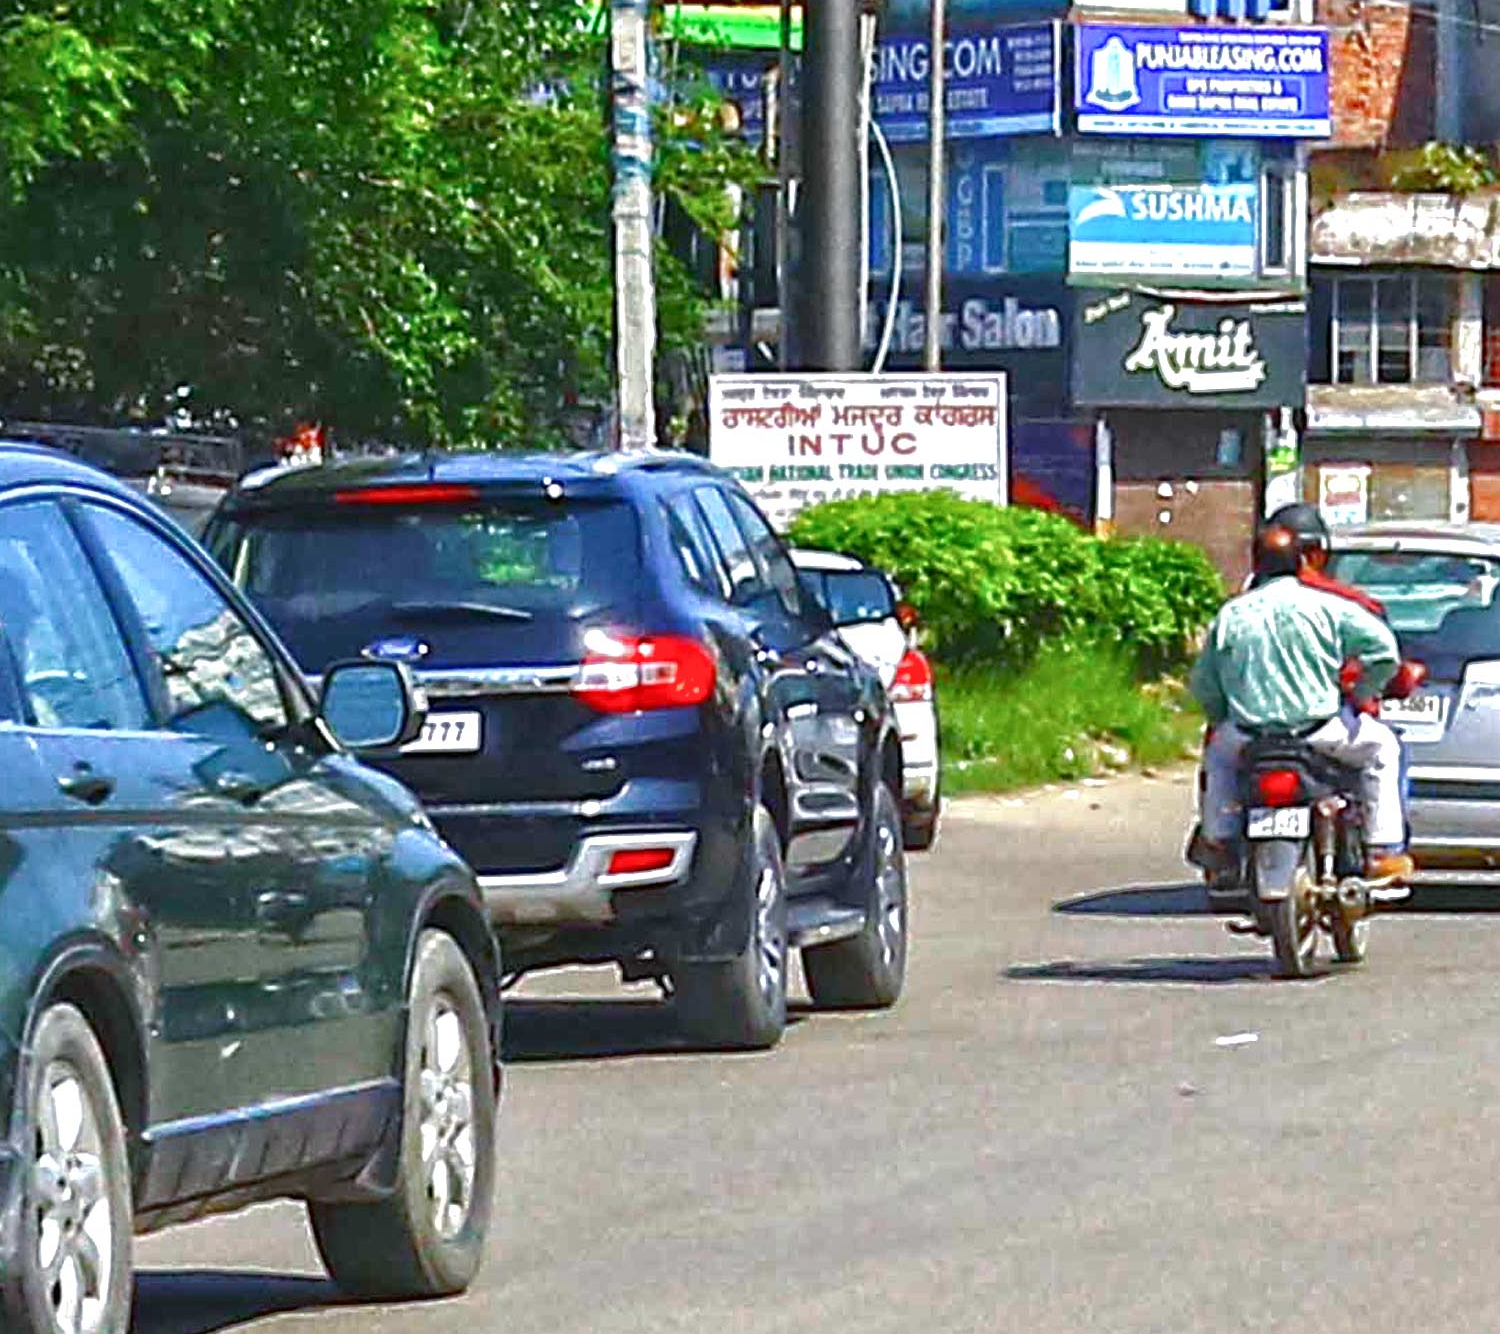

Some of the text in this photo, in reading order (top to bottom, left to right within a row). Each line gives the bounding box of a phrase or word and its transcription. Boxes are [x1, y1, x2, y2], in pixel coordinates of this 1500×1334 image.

[1131, 191, 1251, 222] SUSHMA
[962, 297, 1062, 351] Salon
[1125, 304, 1262, 379] Amit
[787, 432, 918, 456] INTUC
